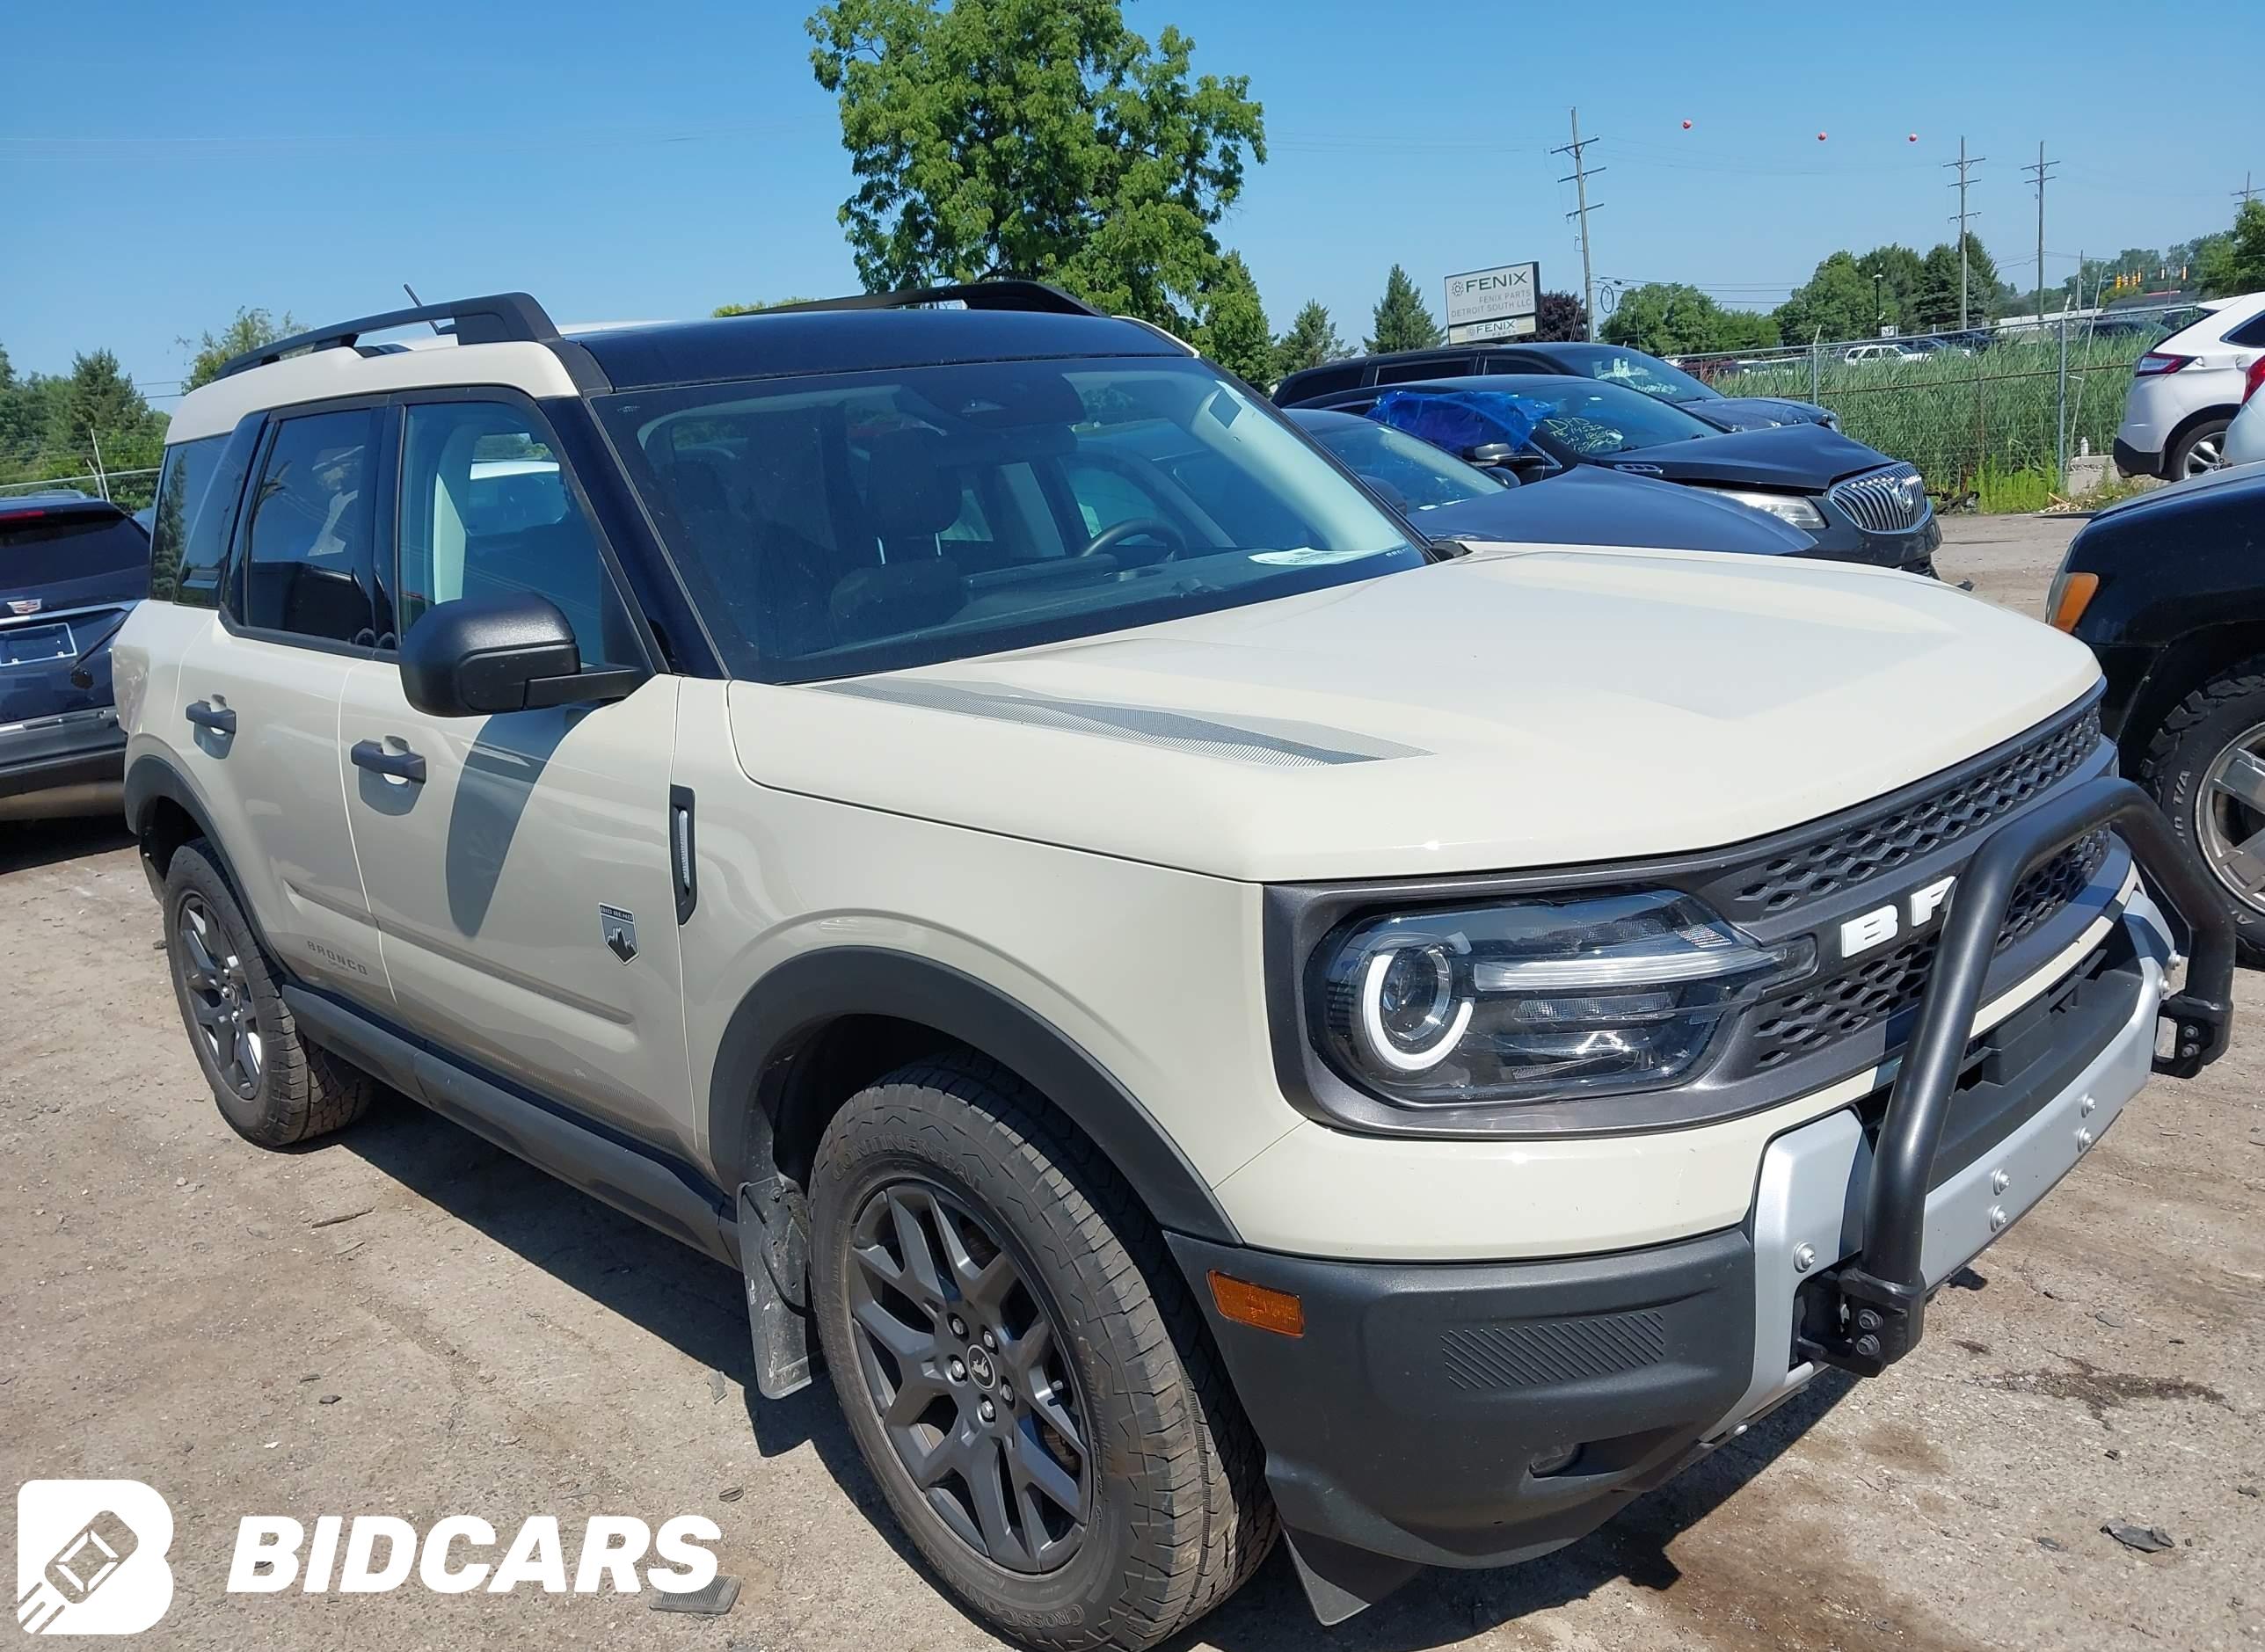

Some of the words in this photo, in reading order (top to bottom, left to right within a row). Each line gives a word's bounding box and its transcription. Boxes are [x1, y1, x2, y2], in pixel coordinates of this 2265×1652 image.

[1466, 271, 1527, 294] FENIX
[1479, 295, 1503, 303] FENIX
[1504, 289, 1532, 300] PARTS
[1451, 305, 1484, 317] DETROIT
[1487, 302, 1514, 312] SOUTH
[1517, 298, 1533, 308] LLC
[1477, 319, 1515, 334] FENIX
[307, 940, 368, 977] BRONCO
[831, 1132, 989, 1202] CONTINENTAL
